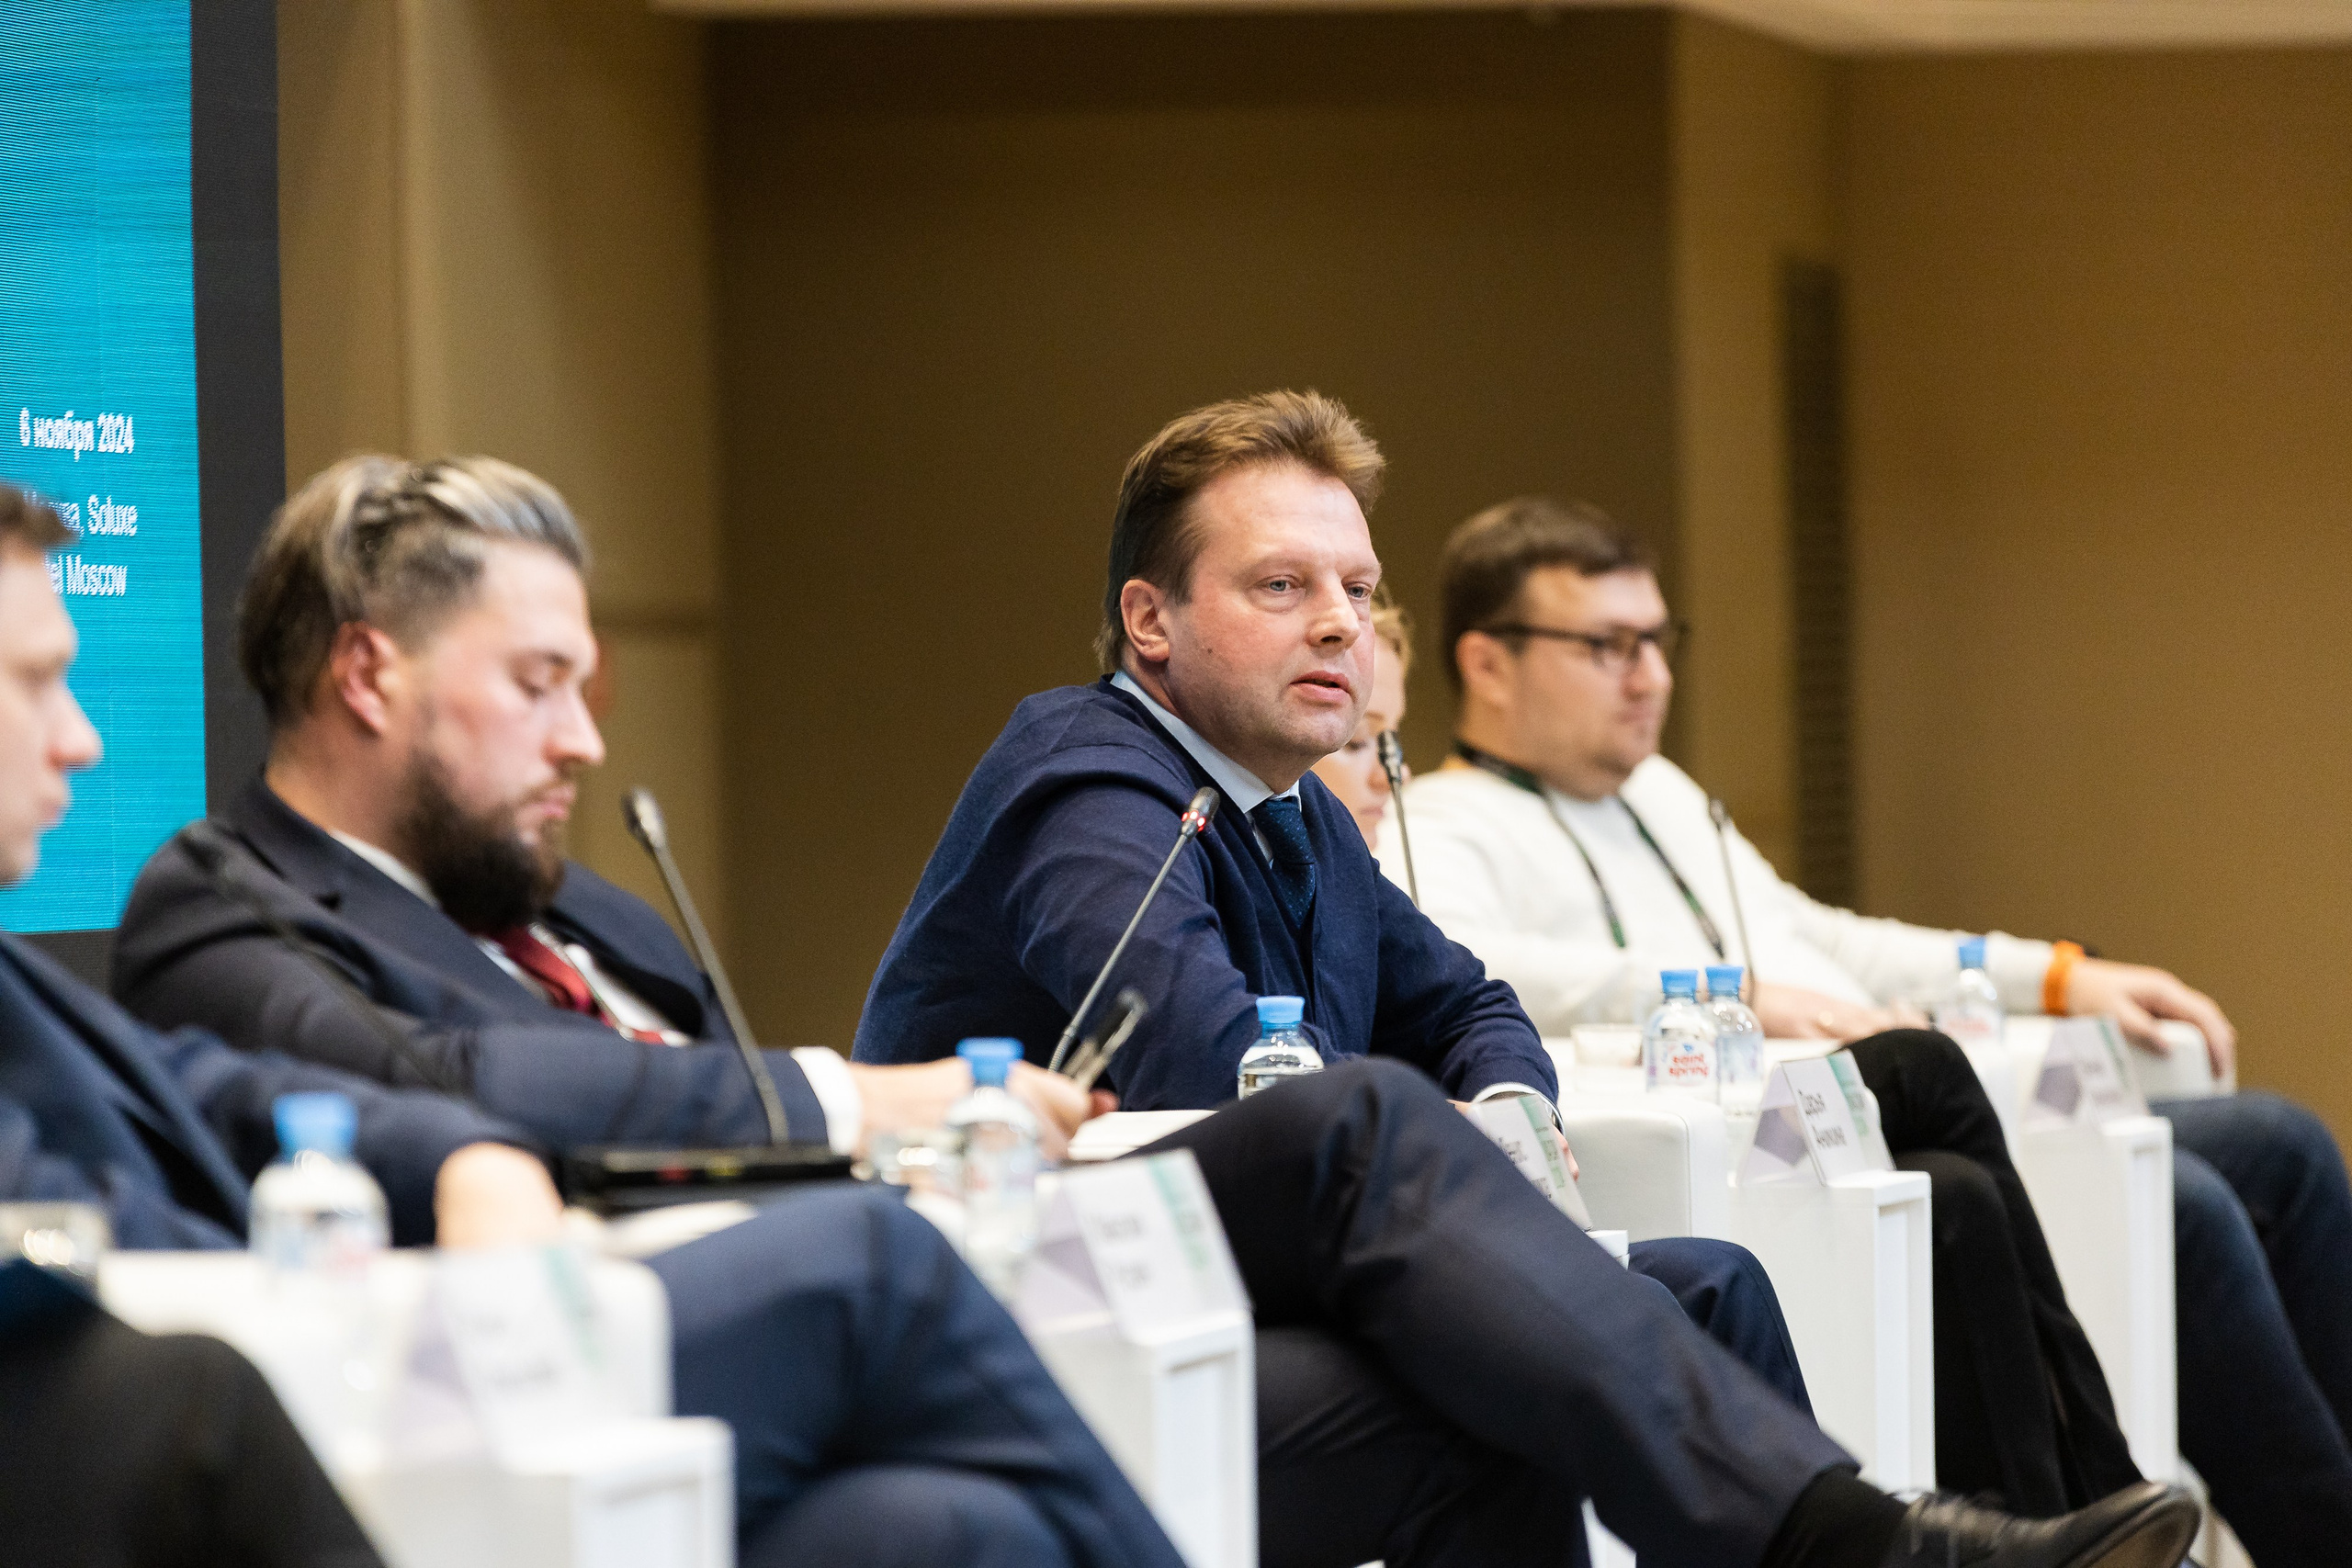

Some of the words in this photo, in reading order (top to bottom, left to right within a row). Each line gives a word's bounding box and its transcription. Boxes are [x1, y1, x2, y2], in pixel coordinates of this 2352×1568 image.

[19, 407, 30, 446] 6
[33, 410, 95, 461] ноября
[97, 412, 135, 453] 2024
[87, 494, 138, 536] Soluxe
[66, 554, 128, 596] Moscow
